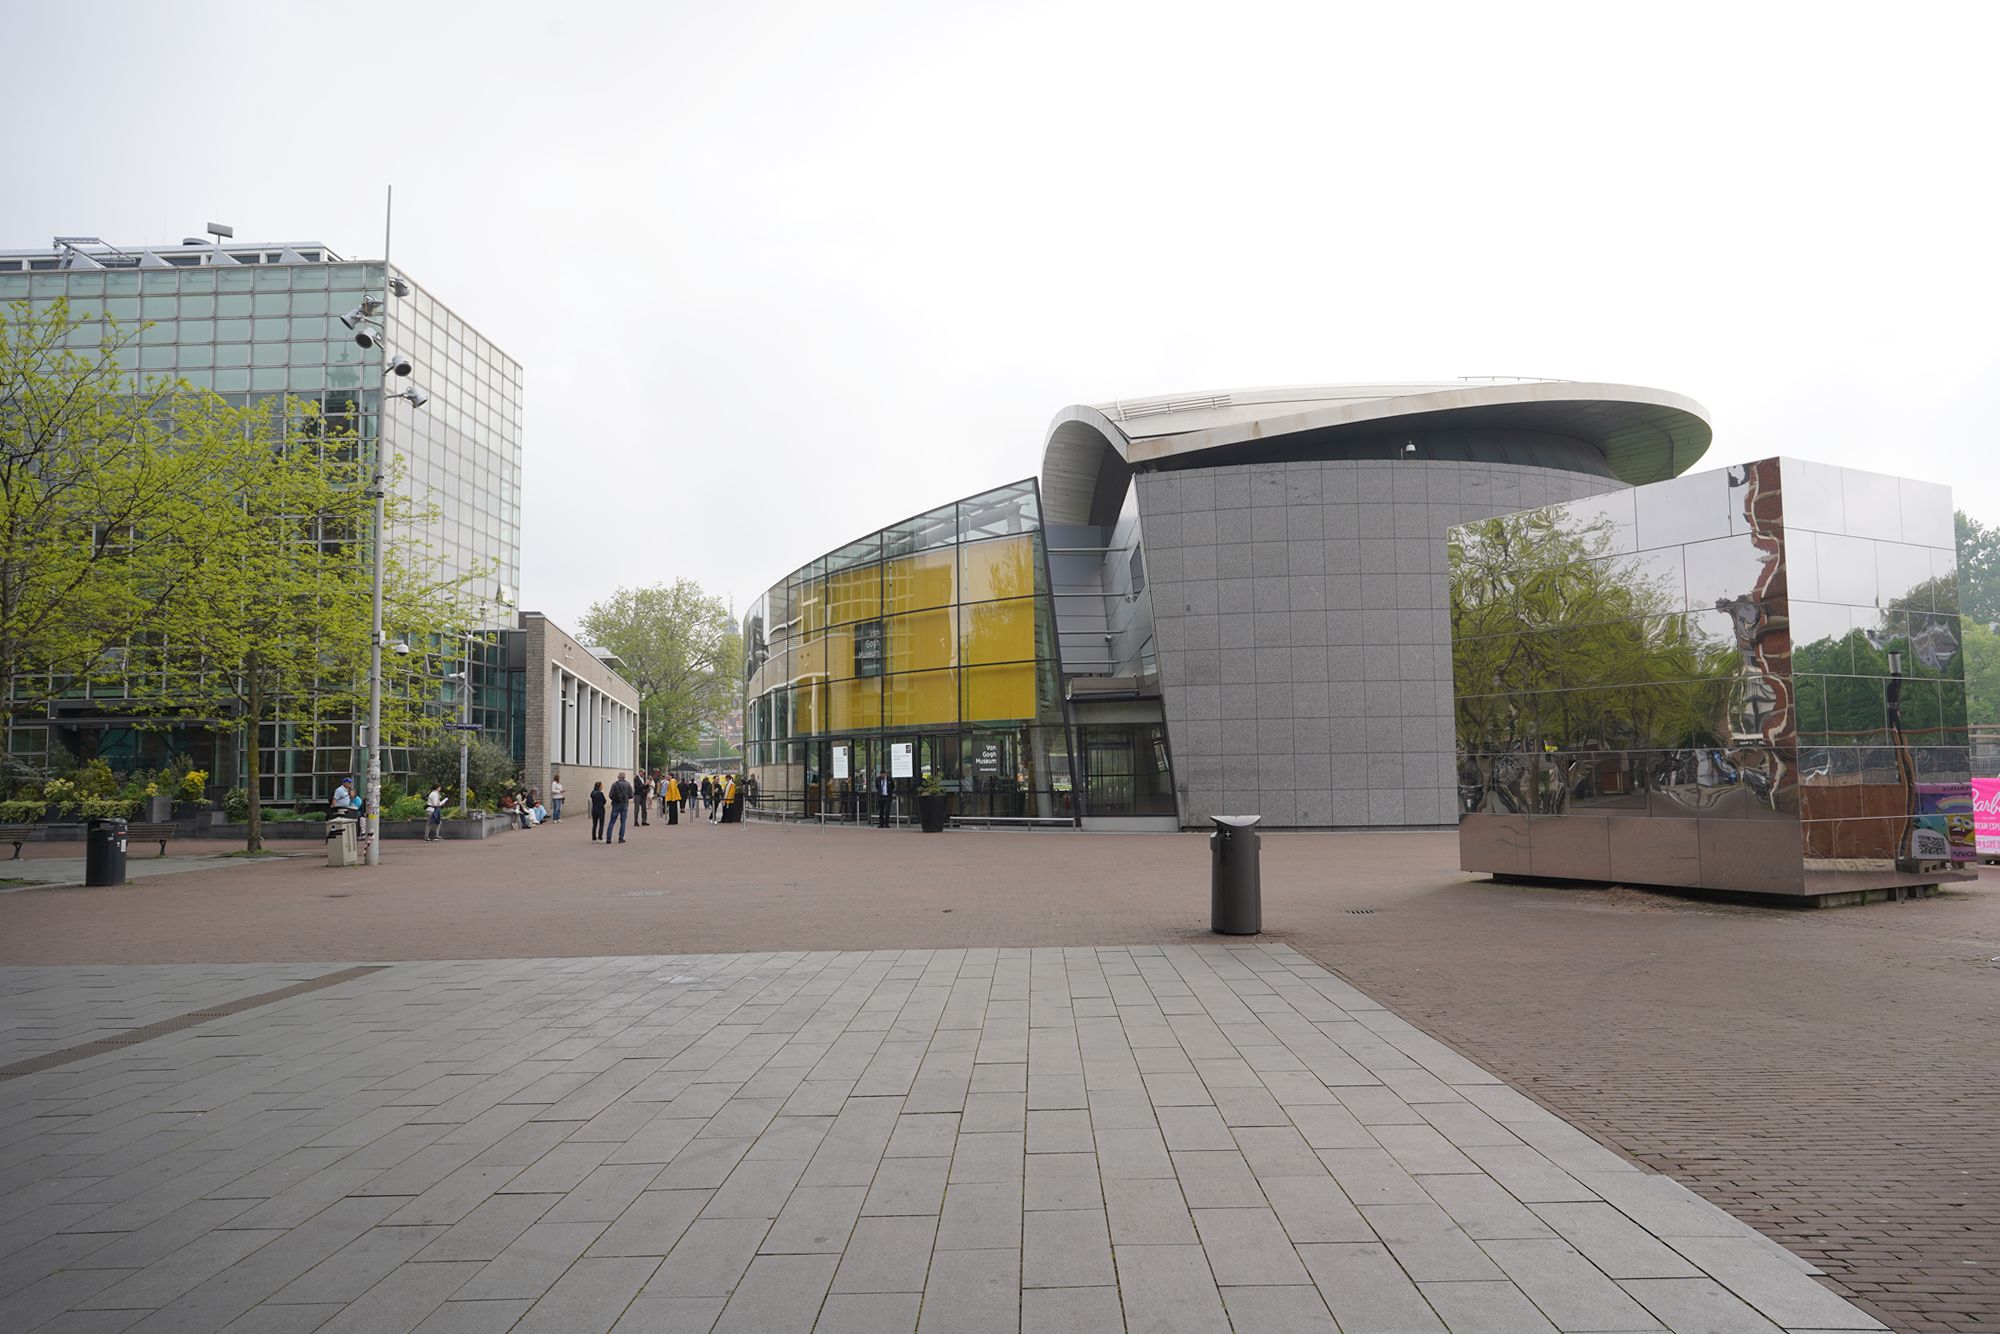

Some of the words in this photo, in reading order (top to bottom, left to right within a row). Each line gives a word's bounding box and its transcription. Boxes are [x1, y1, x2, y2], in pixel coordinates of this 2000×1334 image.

[865, 639, 880, 649] Gogh
[858, 650, 880, 659] Museum
[982, 750, 997, 758] Gogh
[1972, 787, 2000, 815] Barb
